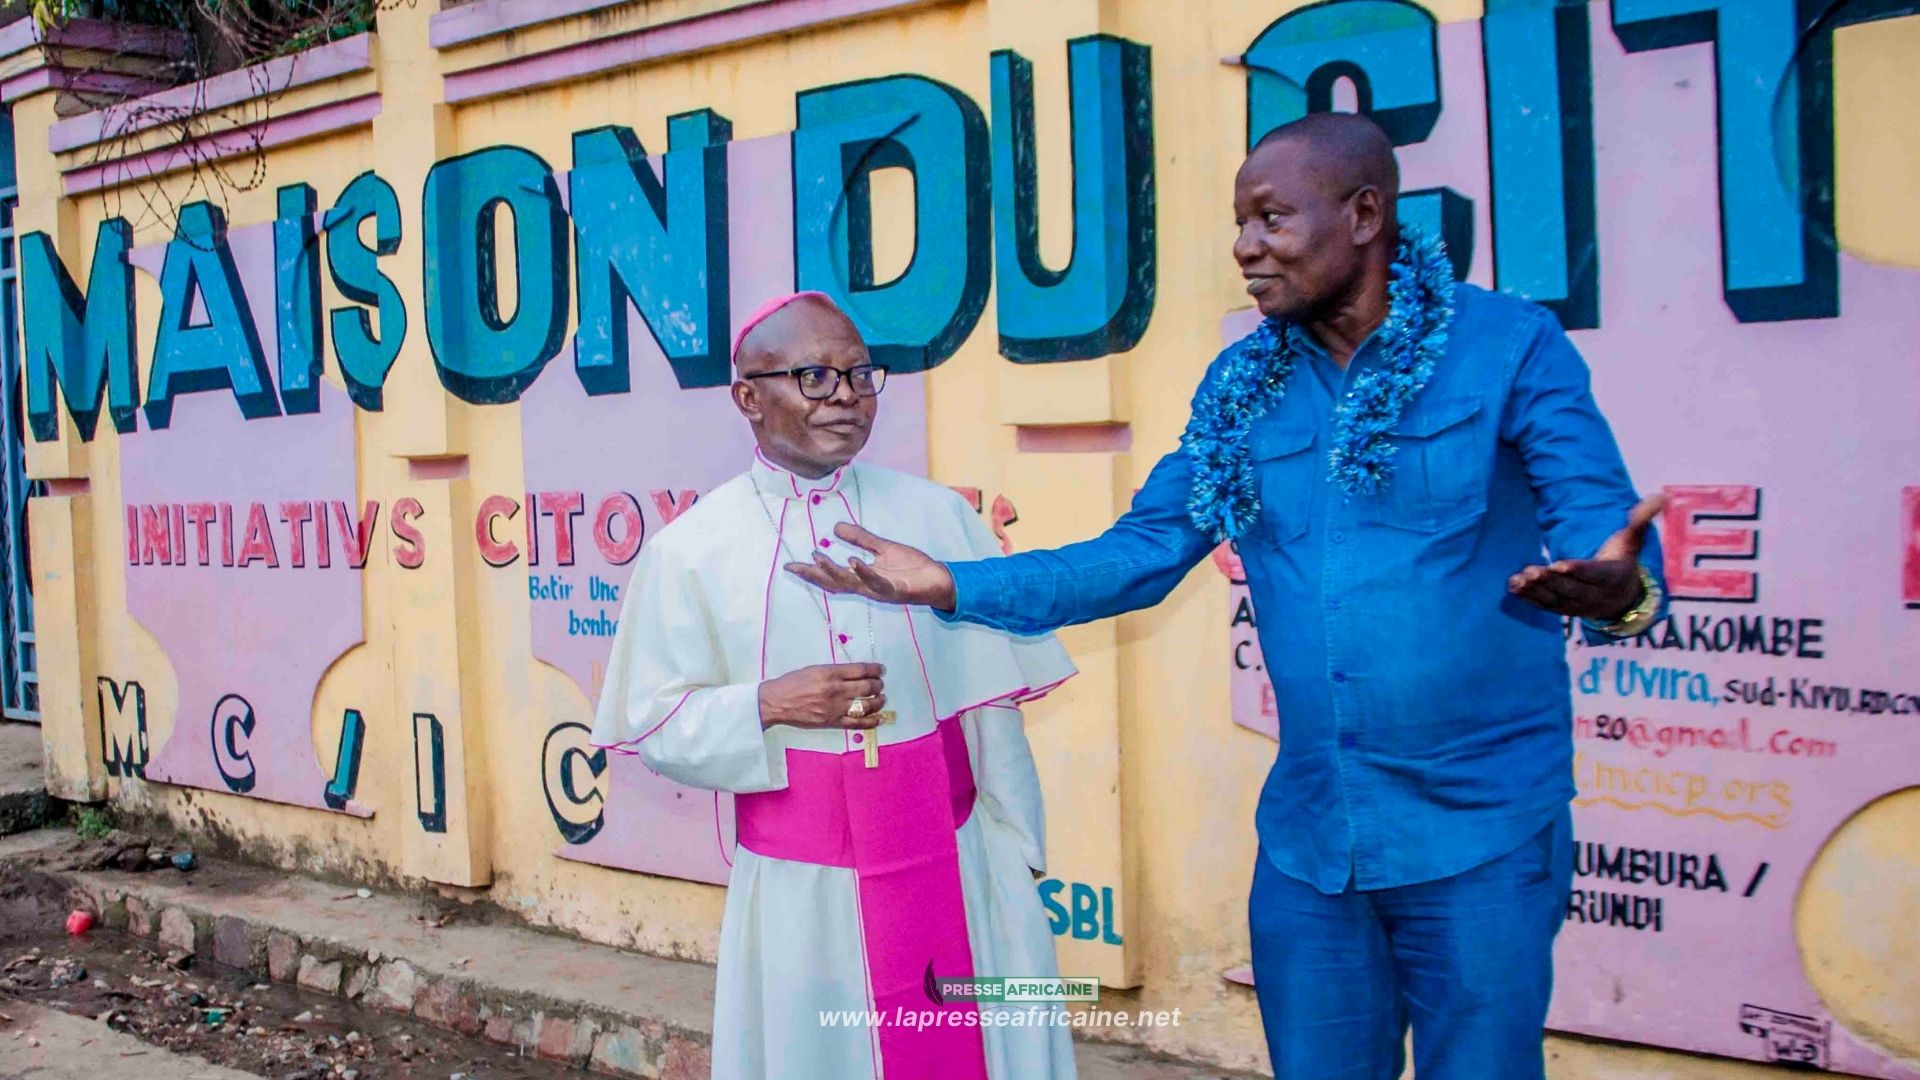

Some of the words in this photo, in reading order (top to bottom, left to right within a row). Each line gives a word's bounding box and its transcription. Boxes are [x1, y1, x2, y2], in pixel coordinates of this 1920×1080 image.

[19, 107, 733, 442] MAISON
[791, 33, 1157, 376] DU
[126, 497, 426, 568] INITIATIVS
